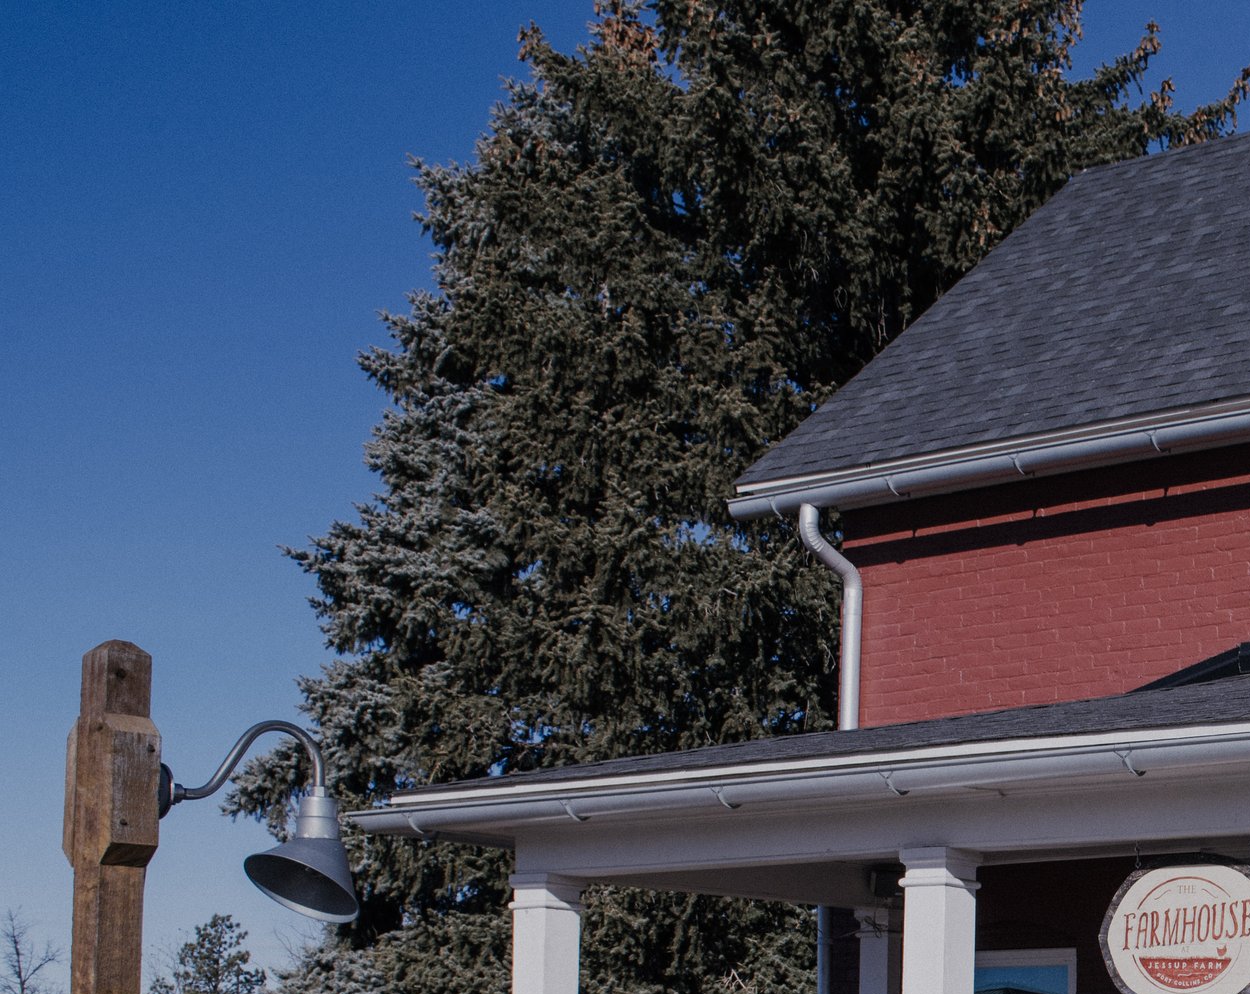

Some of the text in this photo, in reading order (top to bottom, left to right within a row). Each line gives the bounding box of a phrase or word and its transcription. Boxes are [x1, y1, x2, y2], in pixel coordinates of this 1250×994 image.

[1177, 885, 1196, 895] THE
[1147, 961, 1223, 970] JESSUP FARM
[1156, 972, 1172, 985] FORT
[1204, 973, 1213, 981] CO
